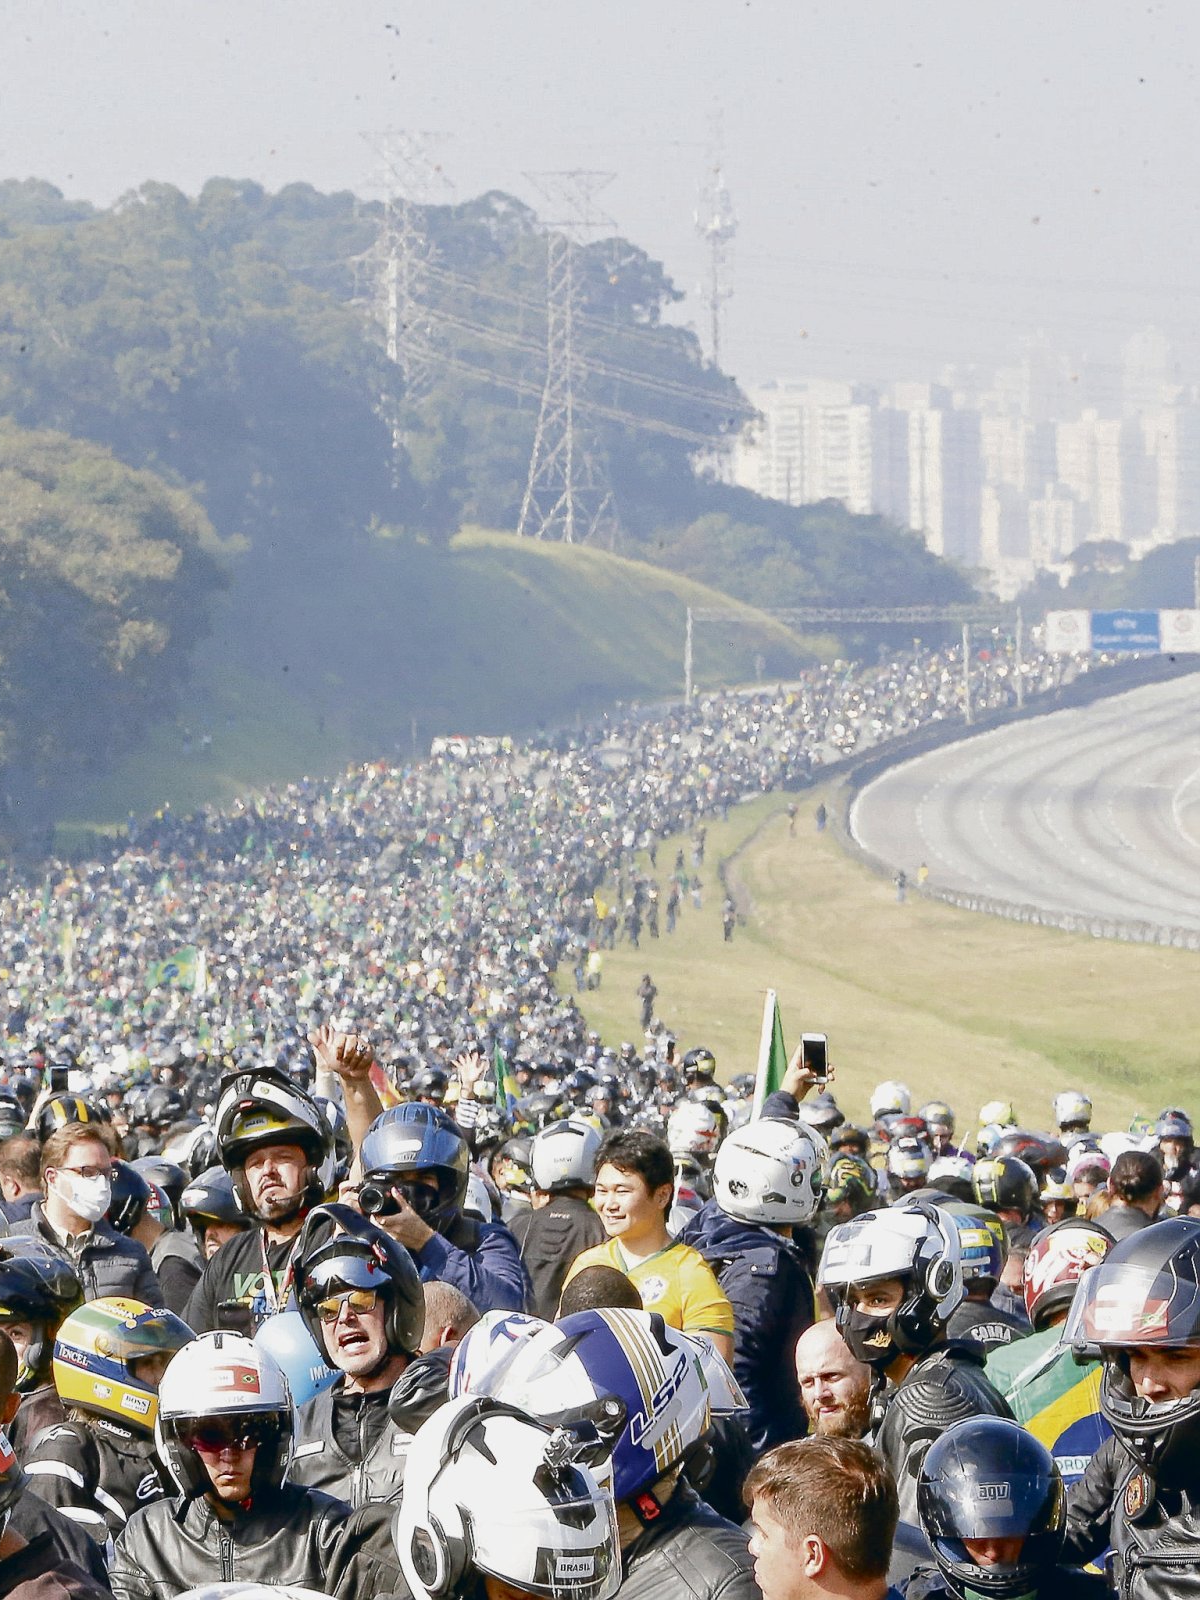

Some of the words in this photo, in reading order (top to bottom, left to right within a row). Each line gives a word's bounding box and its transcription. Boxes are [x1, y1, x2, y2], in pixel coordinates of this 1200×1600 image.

[630, 1352, 690, 1445] LS2
[979, 1485, 1009, 1500] agv
[560, 1563, 591, 1572] BRASIL
